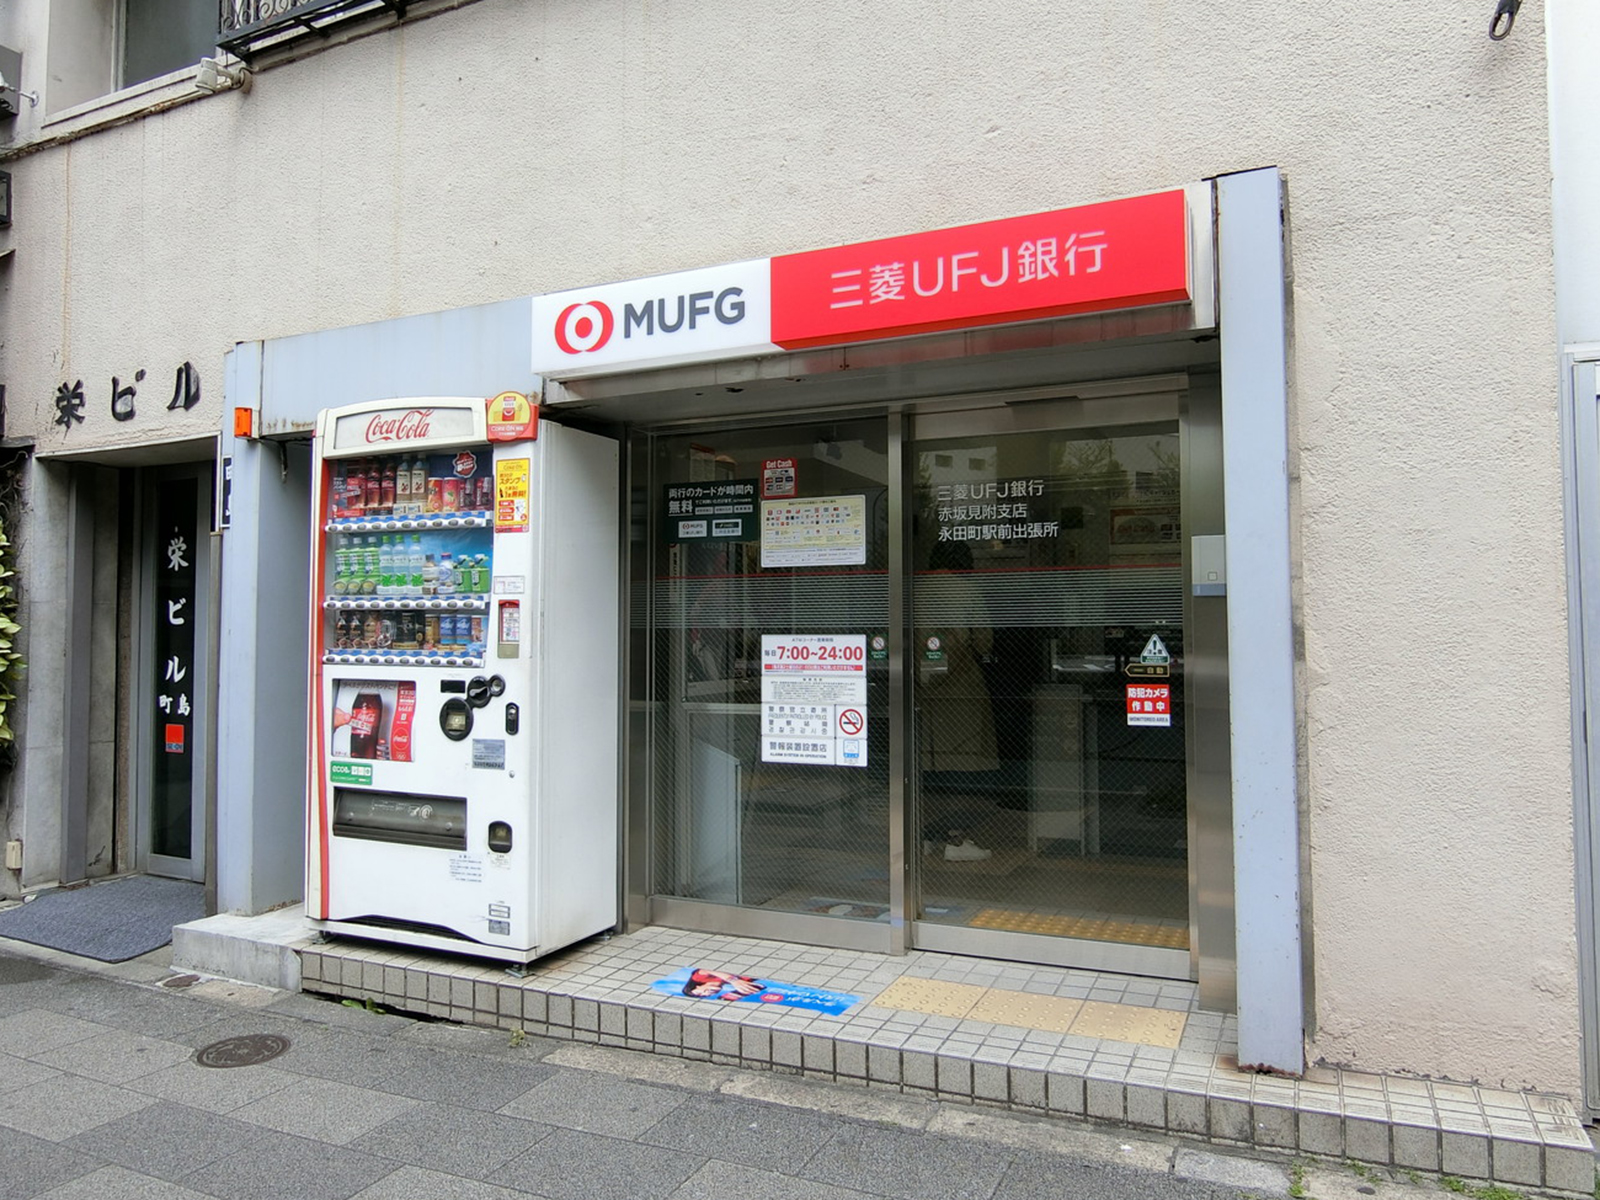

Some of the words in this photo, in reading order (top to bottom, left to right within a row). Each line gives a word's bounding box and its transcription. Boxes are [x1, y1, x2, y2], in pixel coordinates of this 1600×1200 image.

[830, 230, 1108, 309] 三菱UFJ銀行
[623, 286, 746, 339] MUFG
[55, 361, 200, 429] 栄ビル
[365, 409, 434, 443] Coca-Cola
[668, 484, 754, 499] 両行のカードが時間内
[938, 480, 1044, 500] 三菱UFJ銀行
[668, 499, 693, 514] 無料
[938, 503, 1028, 521] 赤坂見附支店
[938, 522, 1059, 541] 永田町駅前出張所
[165, 535, 189, 685] 栄ビル
[764, 649, 776, 657] 毎日
[777, 646, 863, 661] 7:00~24:00
[1127, 687, 1169, 699] 防犯カメラ
[1131, 700, 1165, 712] 作動中
